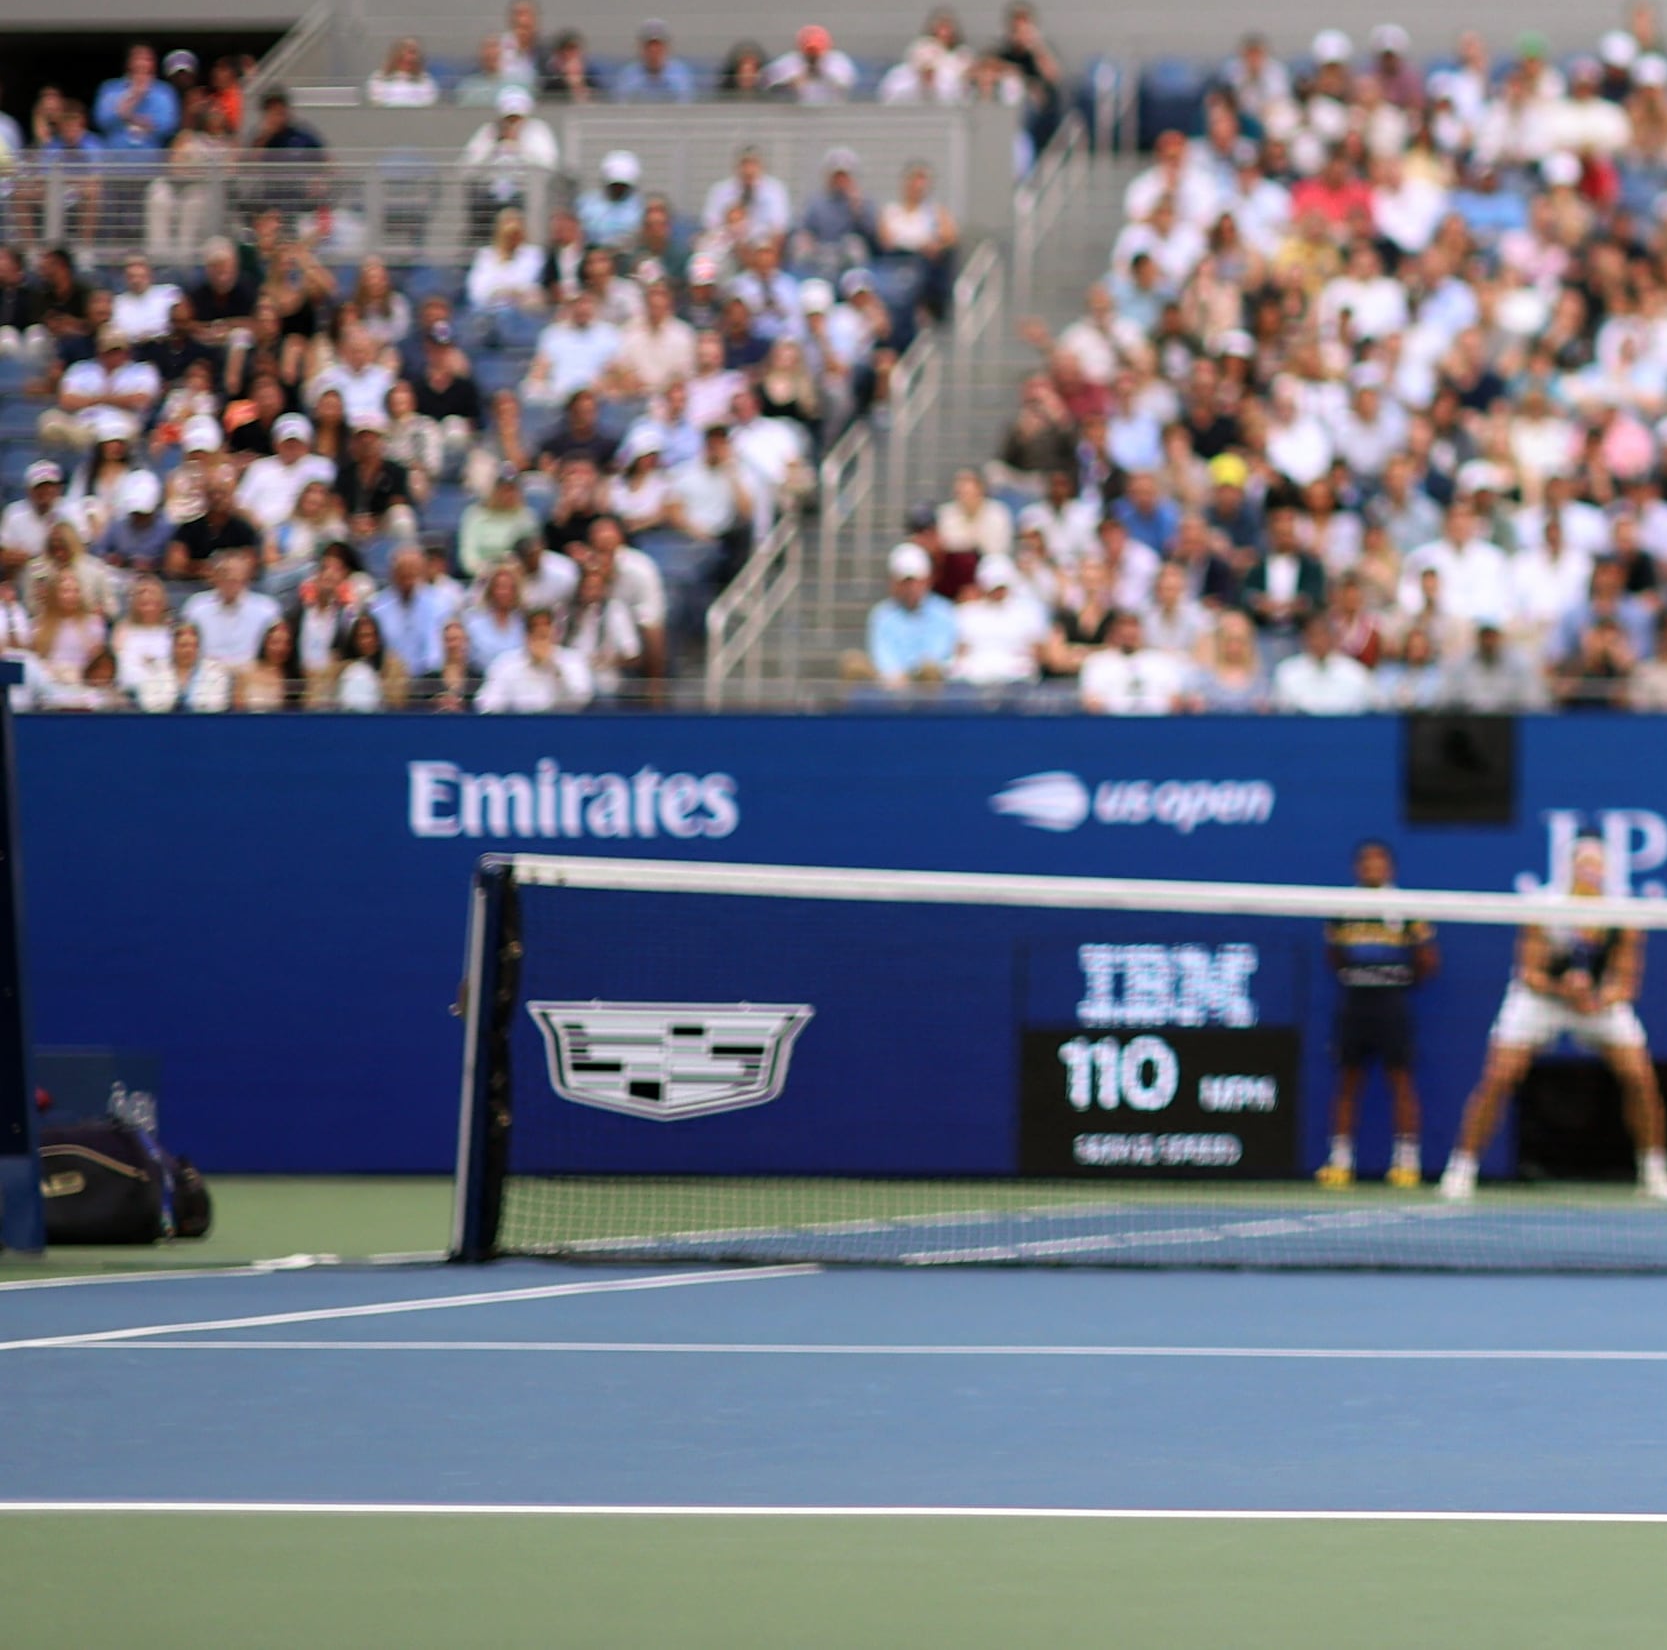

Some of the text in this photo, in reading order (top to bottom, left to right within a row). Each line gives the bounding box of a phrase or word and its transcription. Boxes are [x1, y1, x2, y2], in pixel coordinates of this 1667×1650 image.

[408, 758, 738, 838] Emirates
[1076, 943, 1258, 1028] IBM
[1057, 1035, 1179, 1112] 110
